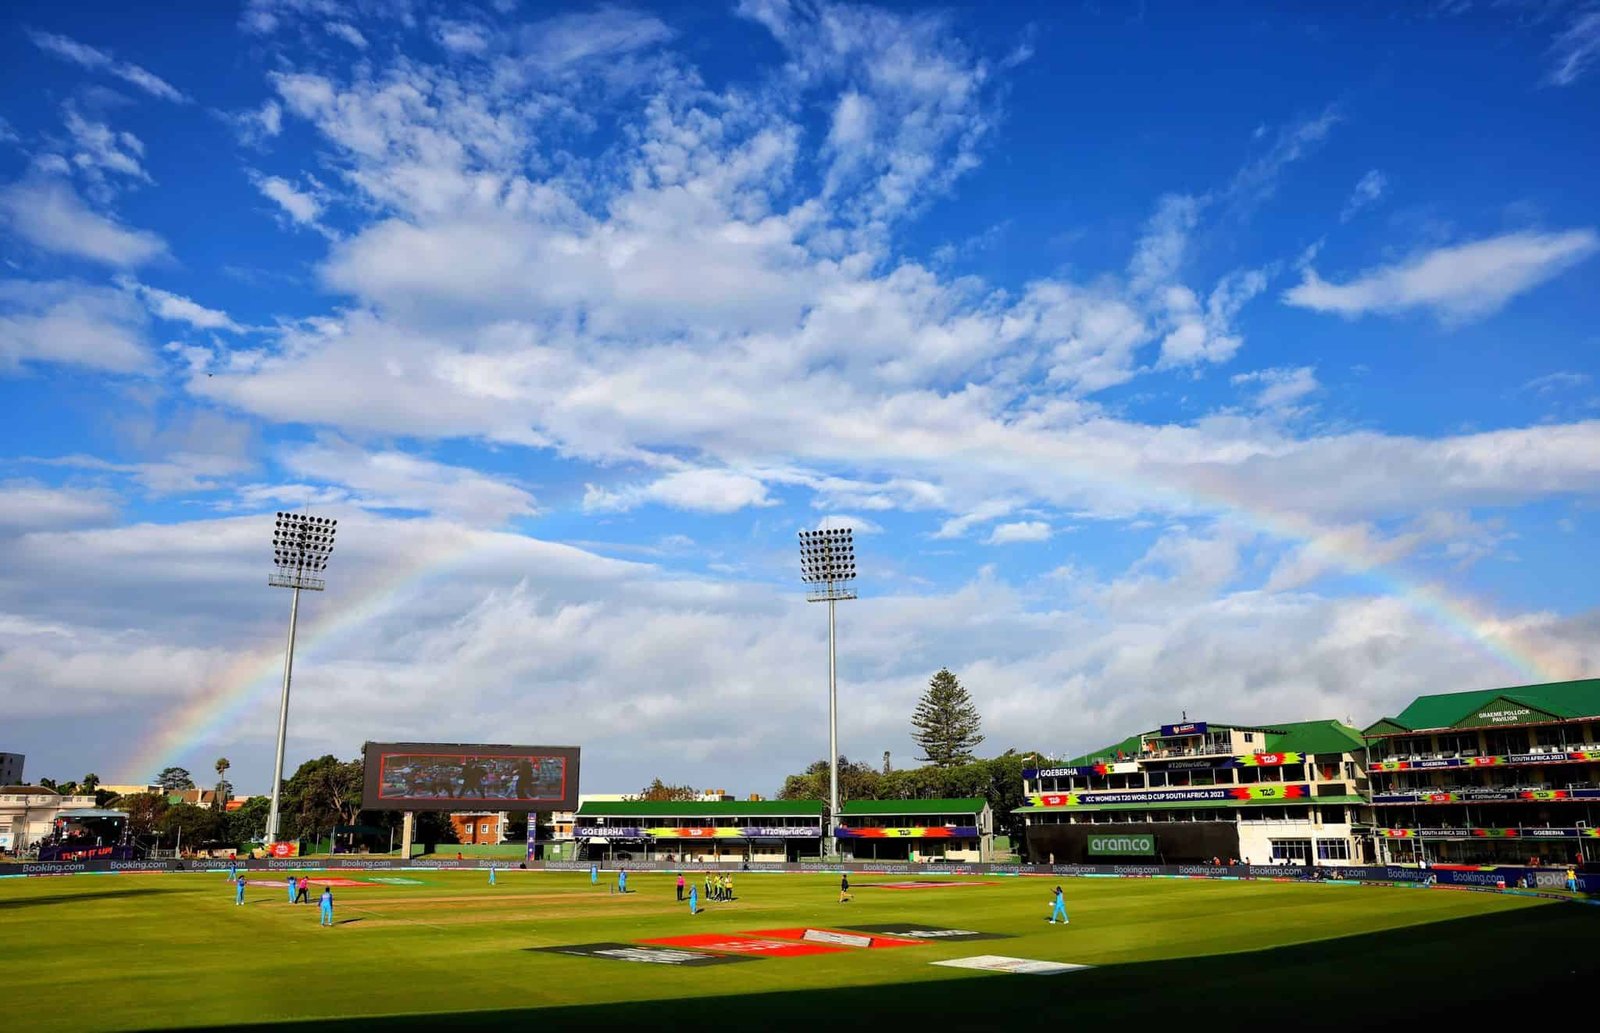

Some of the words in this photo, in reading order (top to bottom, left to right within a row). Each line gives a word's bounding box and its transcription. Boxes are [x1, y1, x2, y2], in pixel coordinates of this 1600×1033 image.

[1166, 792, 1186, 800] SOUTH
[1187, 791, 1208, 799] AFRICA
[1209, 790, 1225, 798] 2023
[760, 828, 813, 837] #T20WorldCup
[1092, 838, 1150, 851] aramco
[110, 861, 168, 870] Booking.com
[268, 861, 320, 869] Booking.com
[341, 860, 391, 868] Booking.com
[411, 860, 459, 868] Booking.com
[612, 861, 656, 869] Booking.com
[674, 862, 719, 870] Booking.com
[863, 863, 908, 871] Booking.com
[926, 864, 972, 872] Booking.com
[990, 864, 1035, 872] Booking.com
[22, 864, 85, 873] Booking.com
[1052, 865, 1096, 873] Booking.com
[1114, 866, 1160, 874] Booking.com
[1178, 865, 1228, 875] Booking.com
[1249, 867, 1302, 876] Booking.com
[1453, 871, 1505, 886] Booking.com
